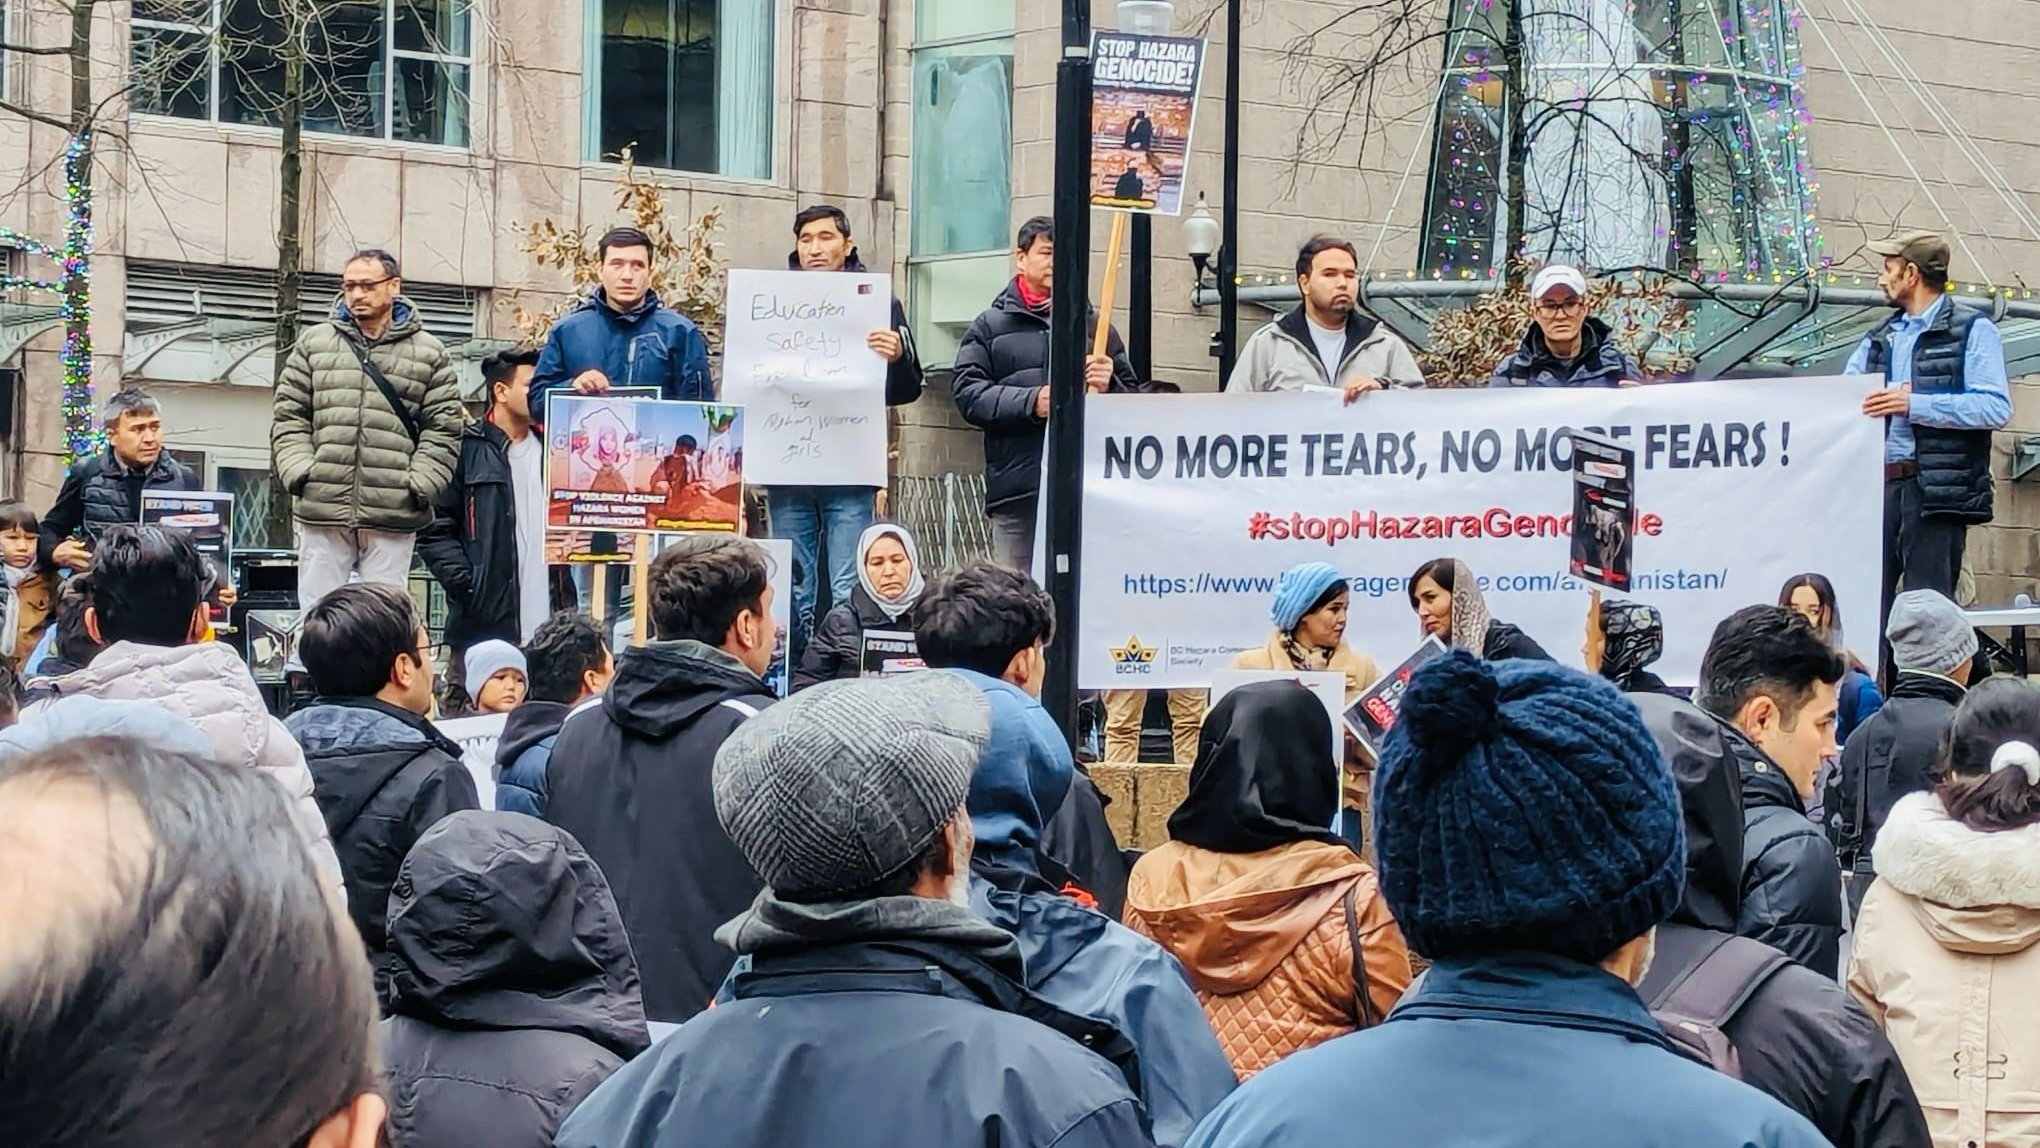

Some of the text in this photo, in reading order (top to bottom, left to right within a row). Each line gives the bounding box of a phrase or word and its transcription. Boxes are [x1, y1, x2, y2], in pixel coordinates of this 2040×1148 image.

[1097, 38, 1196, 62] STOP HAZARA
[1093, 57, 1195, 86] GENOCIDE!
[751, 294, 846, 321] Education
[1104, 435, 1164, 480] NO
[1174, 434, 1288, 479] MORE
[1300, 430, 1428, 481] TEARS,
[1440, 428, 1502, 474] NO
[1514, 425, 1632, 473] MO
[1644, 420, 1767, 470] FEARS
[1247, 506, 1663, 547] #stopHazaraGenoe
